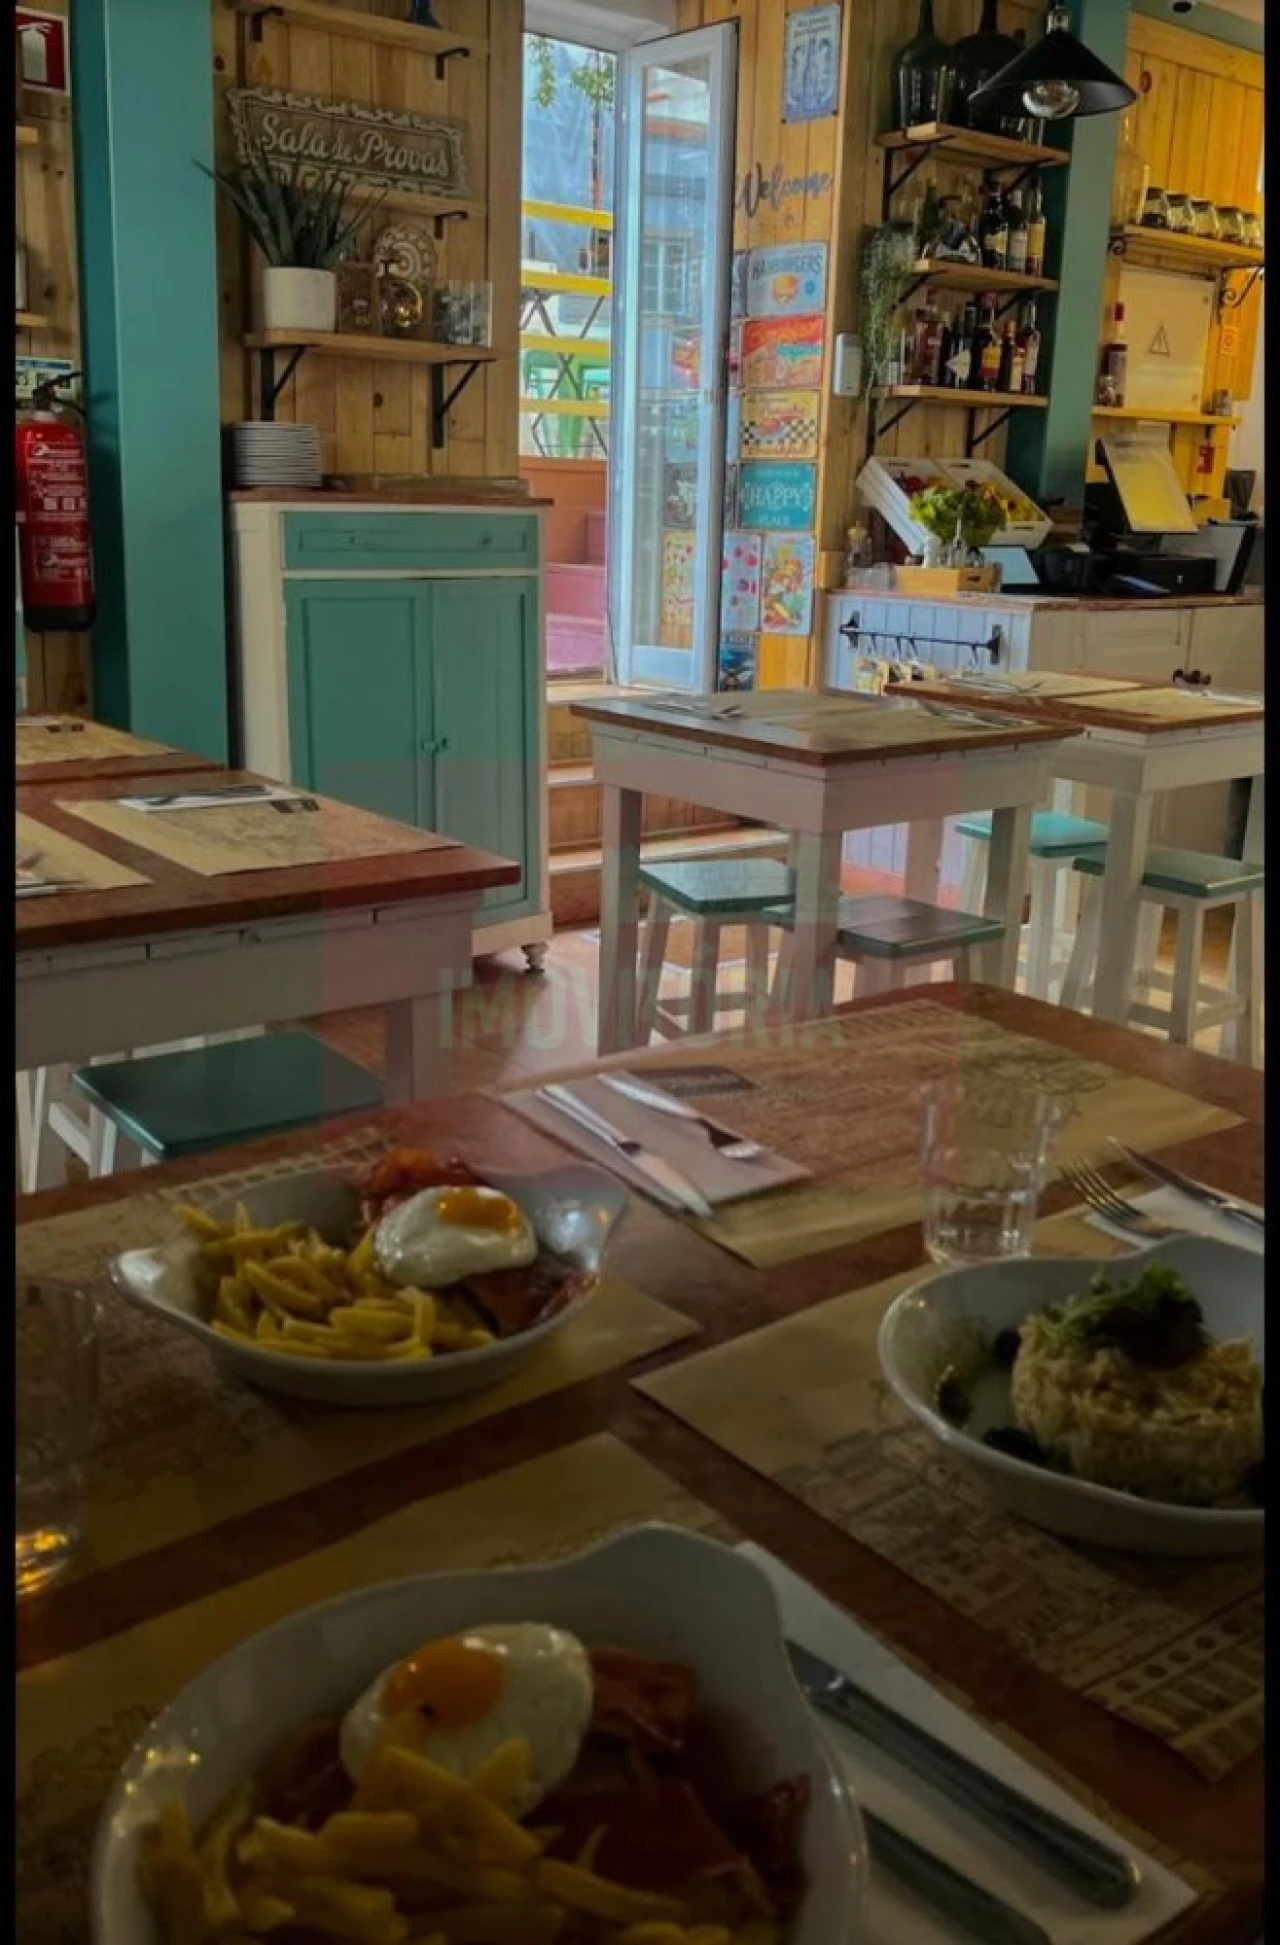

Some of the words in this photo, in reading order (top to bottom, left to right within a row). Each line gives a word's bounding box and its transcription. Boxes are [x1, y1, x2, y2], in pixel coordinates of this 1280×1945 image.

[260, 112, 330, 159] Sala
[356, 129, 452, 177] Provas
[736, 160, 833, 219] Welcome
[750, 486, 804, 508] HAPPY
